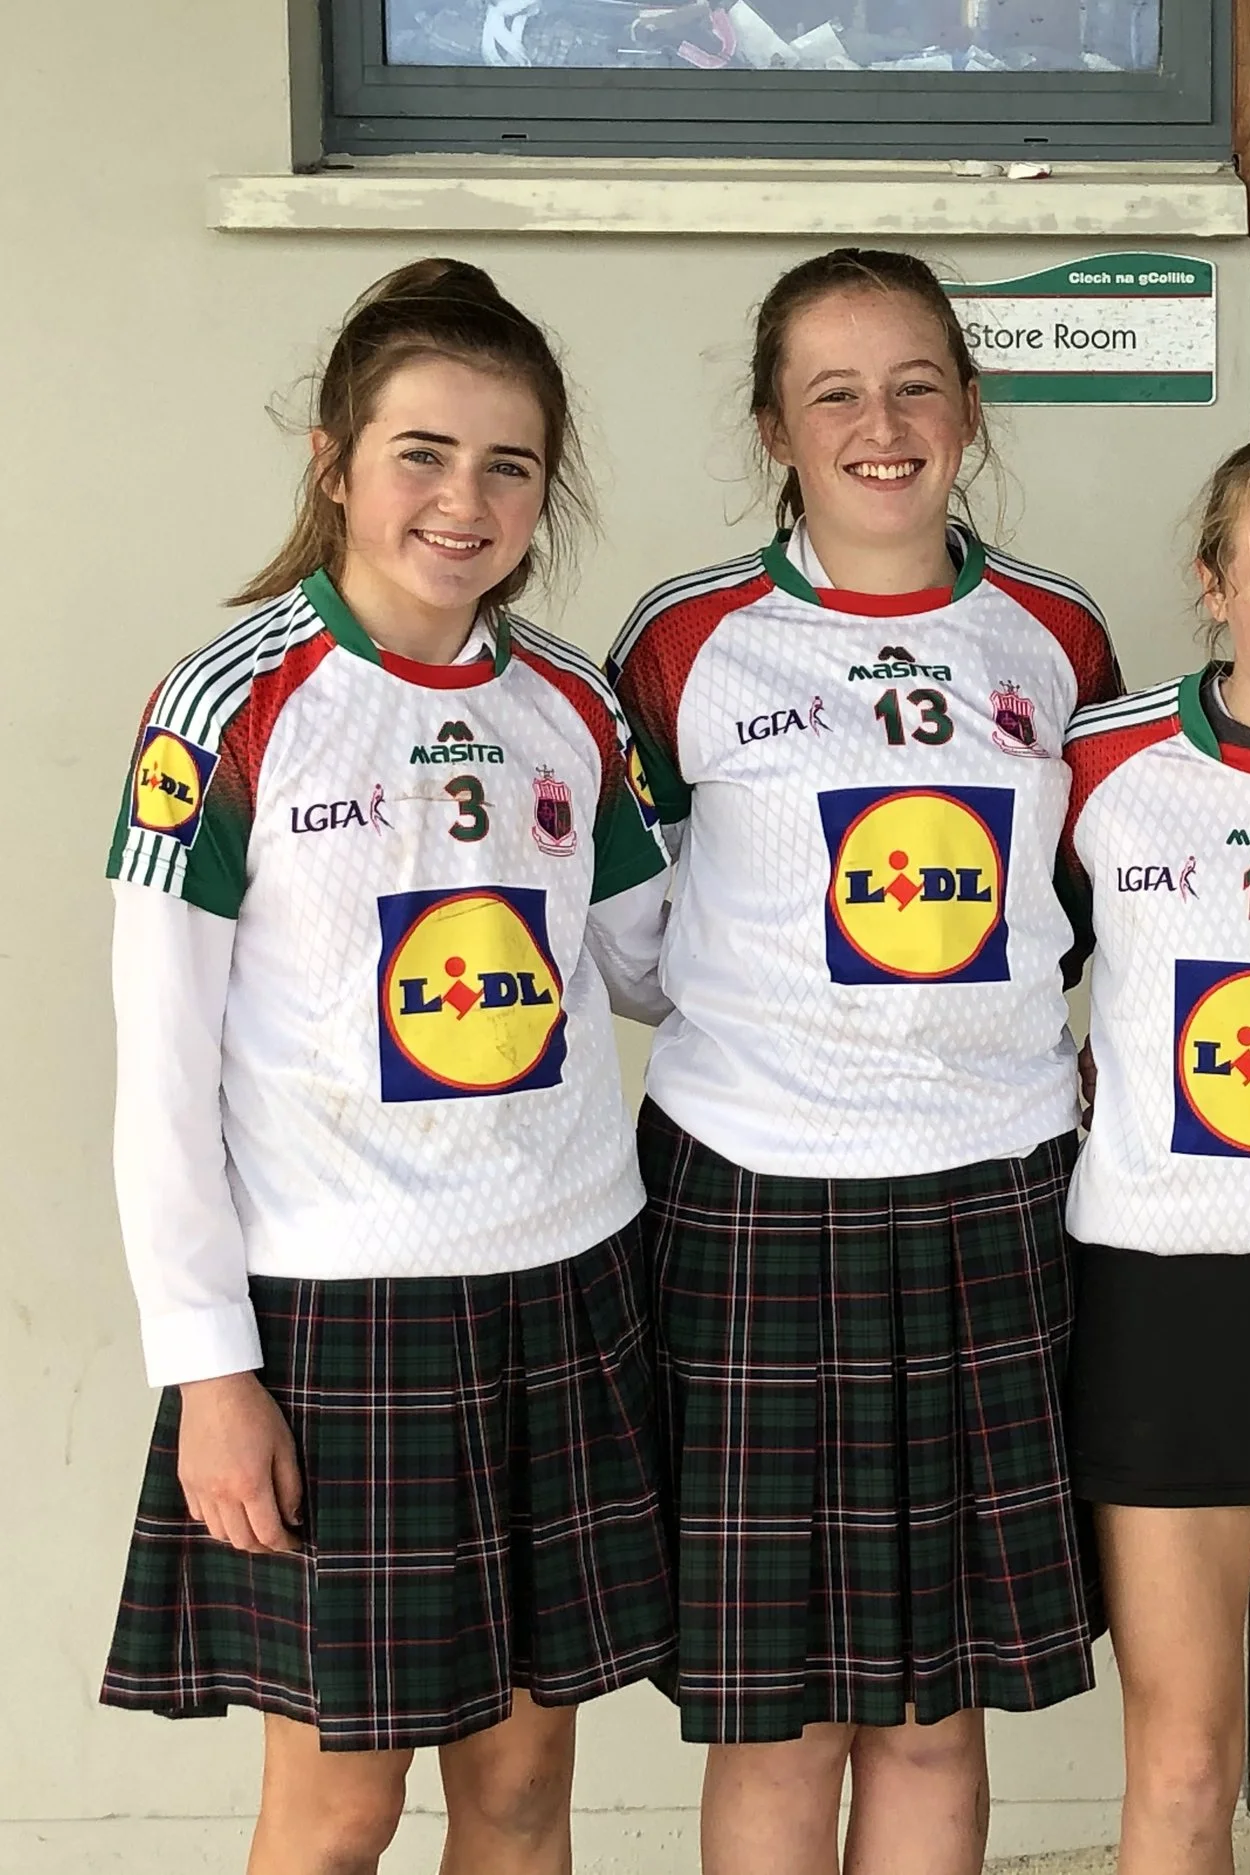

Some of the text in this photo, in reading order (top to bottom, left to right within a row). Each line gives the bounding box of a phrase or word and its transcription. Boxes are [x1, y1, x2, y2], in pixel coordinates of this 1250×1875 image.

[1069, 272, 1112, 284] Cloch
[1116, 274, 1135, 284] na
[966, 323, 1137, 350] Store Room
[736, 708, 808, 746] LGFA
[874, 688, 954, 746] 13
[290, 801, 366, 834] LGFA
[444, 775, 490, 842] 3
[1117, 866, 1177, 893] LGFA
